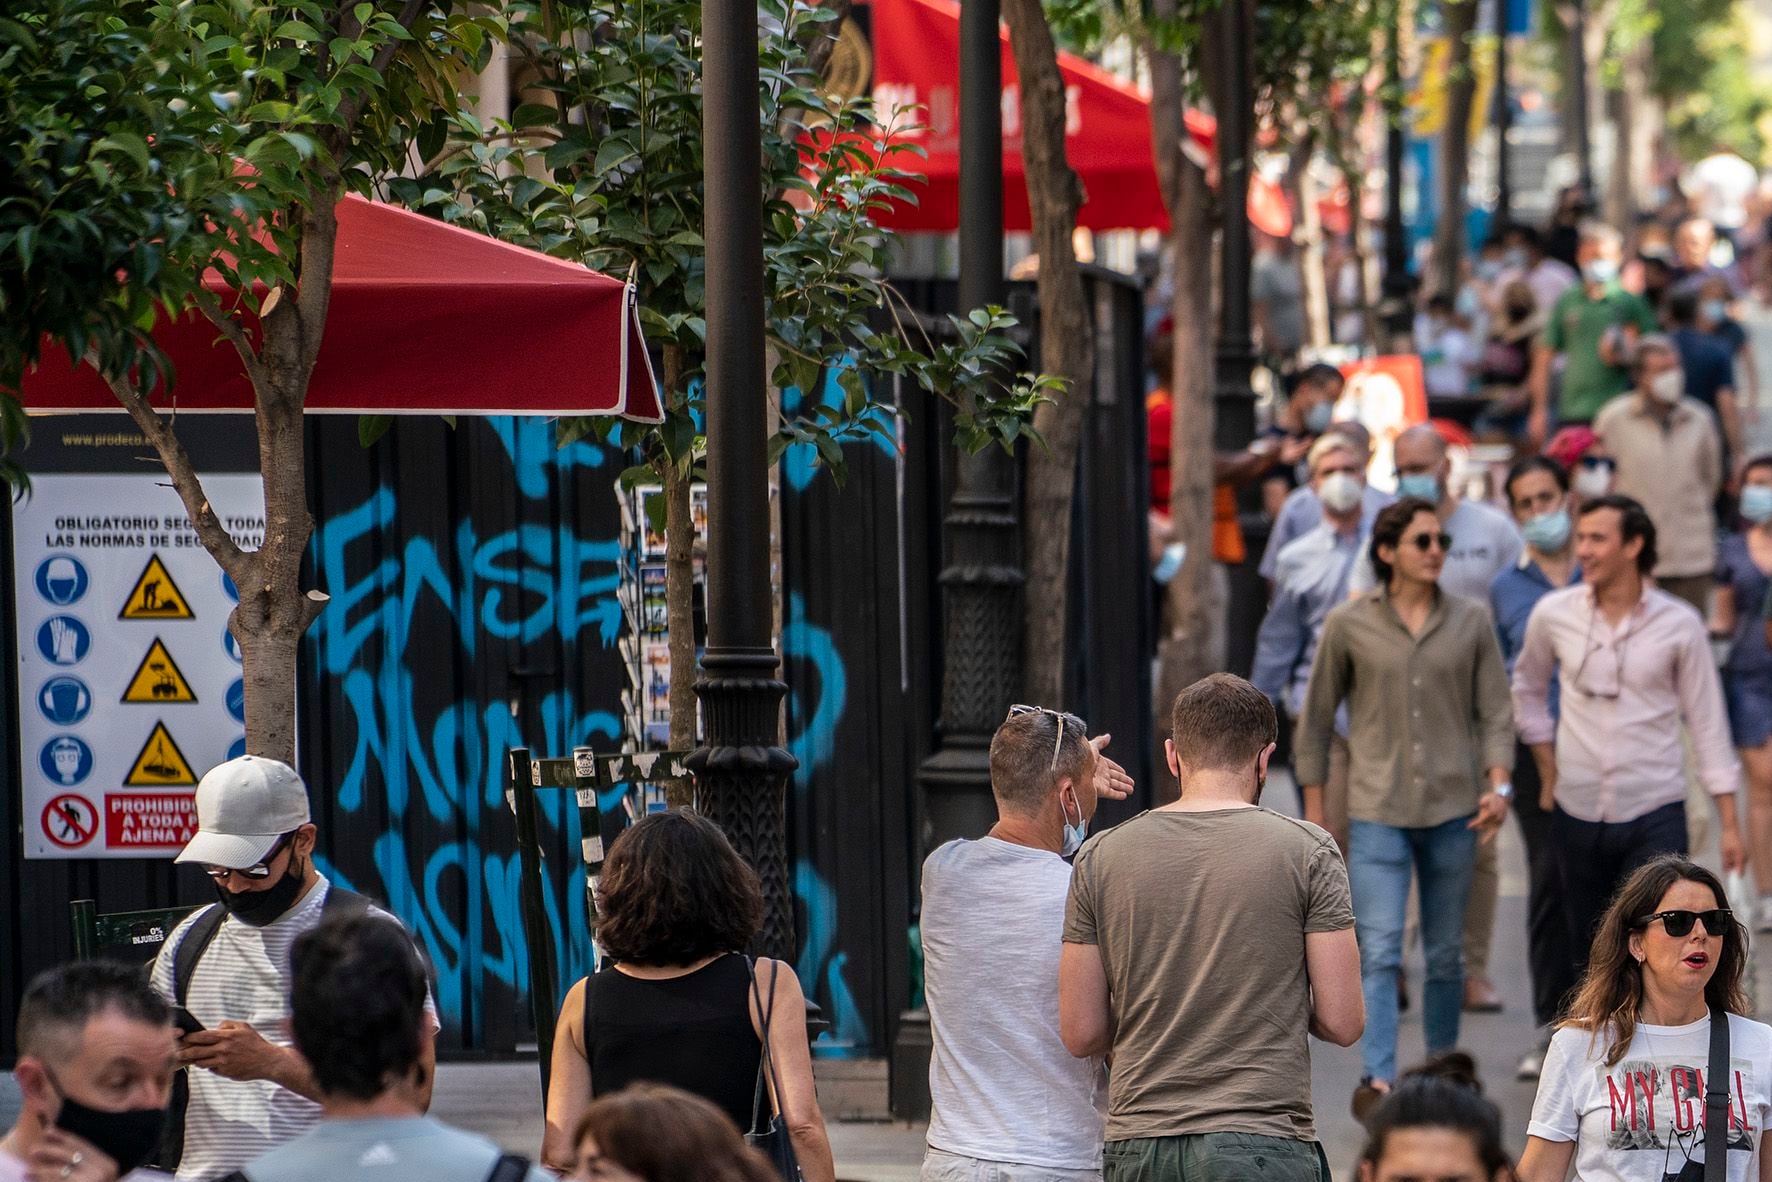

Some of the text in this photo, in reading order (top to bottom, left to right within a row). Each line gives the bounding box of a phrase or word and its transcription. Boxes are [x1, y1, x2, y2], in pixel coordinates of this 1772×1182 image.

[62, 432, 152, 448] www.prodeco.e
[55, 517, 159, 531] OBLIGATORIO
[226, 517, 264, 531] TODA
[46, 534, 262, 548] LAS NORMAS DE SEGDAD
[111, 798, 196, 813] PROHIBID
[123, 814, 135, 829] A
[139, 814, 184, 829] TODA
[121, 828, 176, 843] AJENA
[1606, 1066, 1757, 1132] MY GIL
